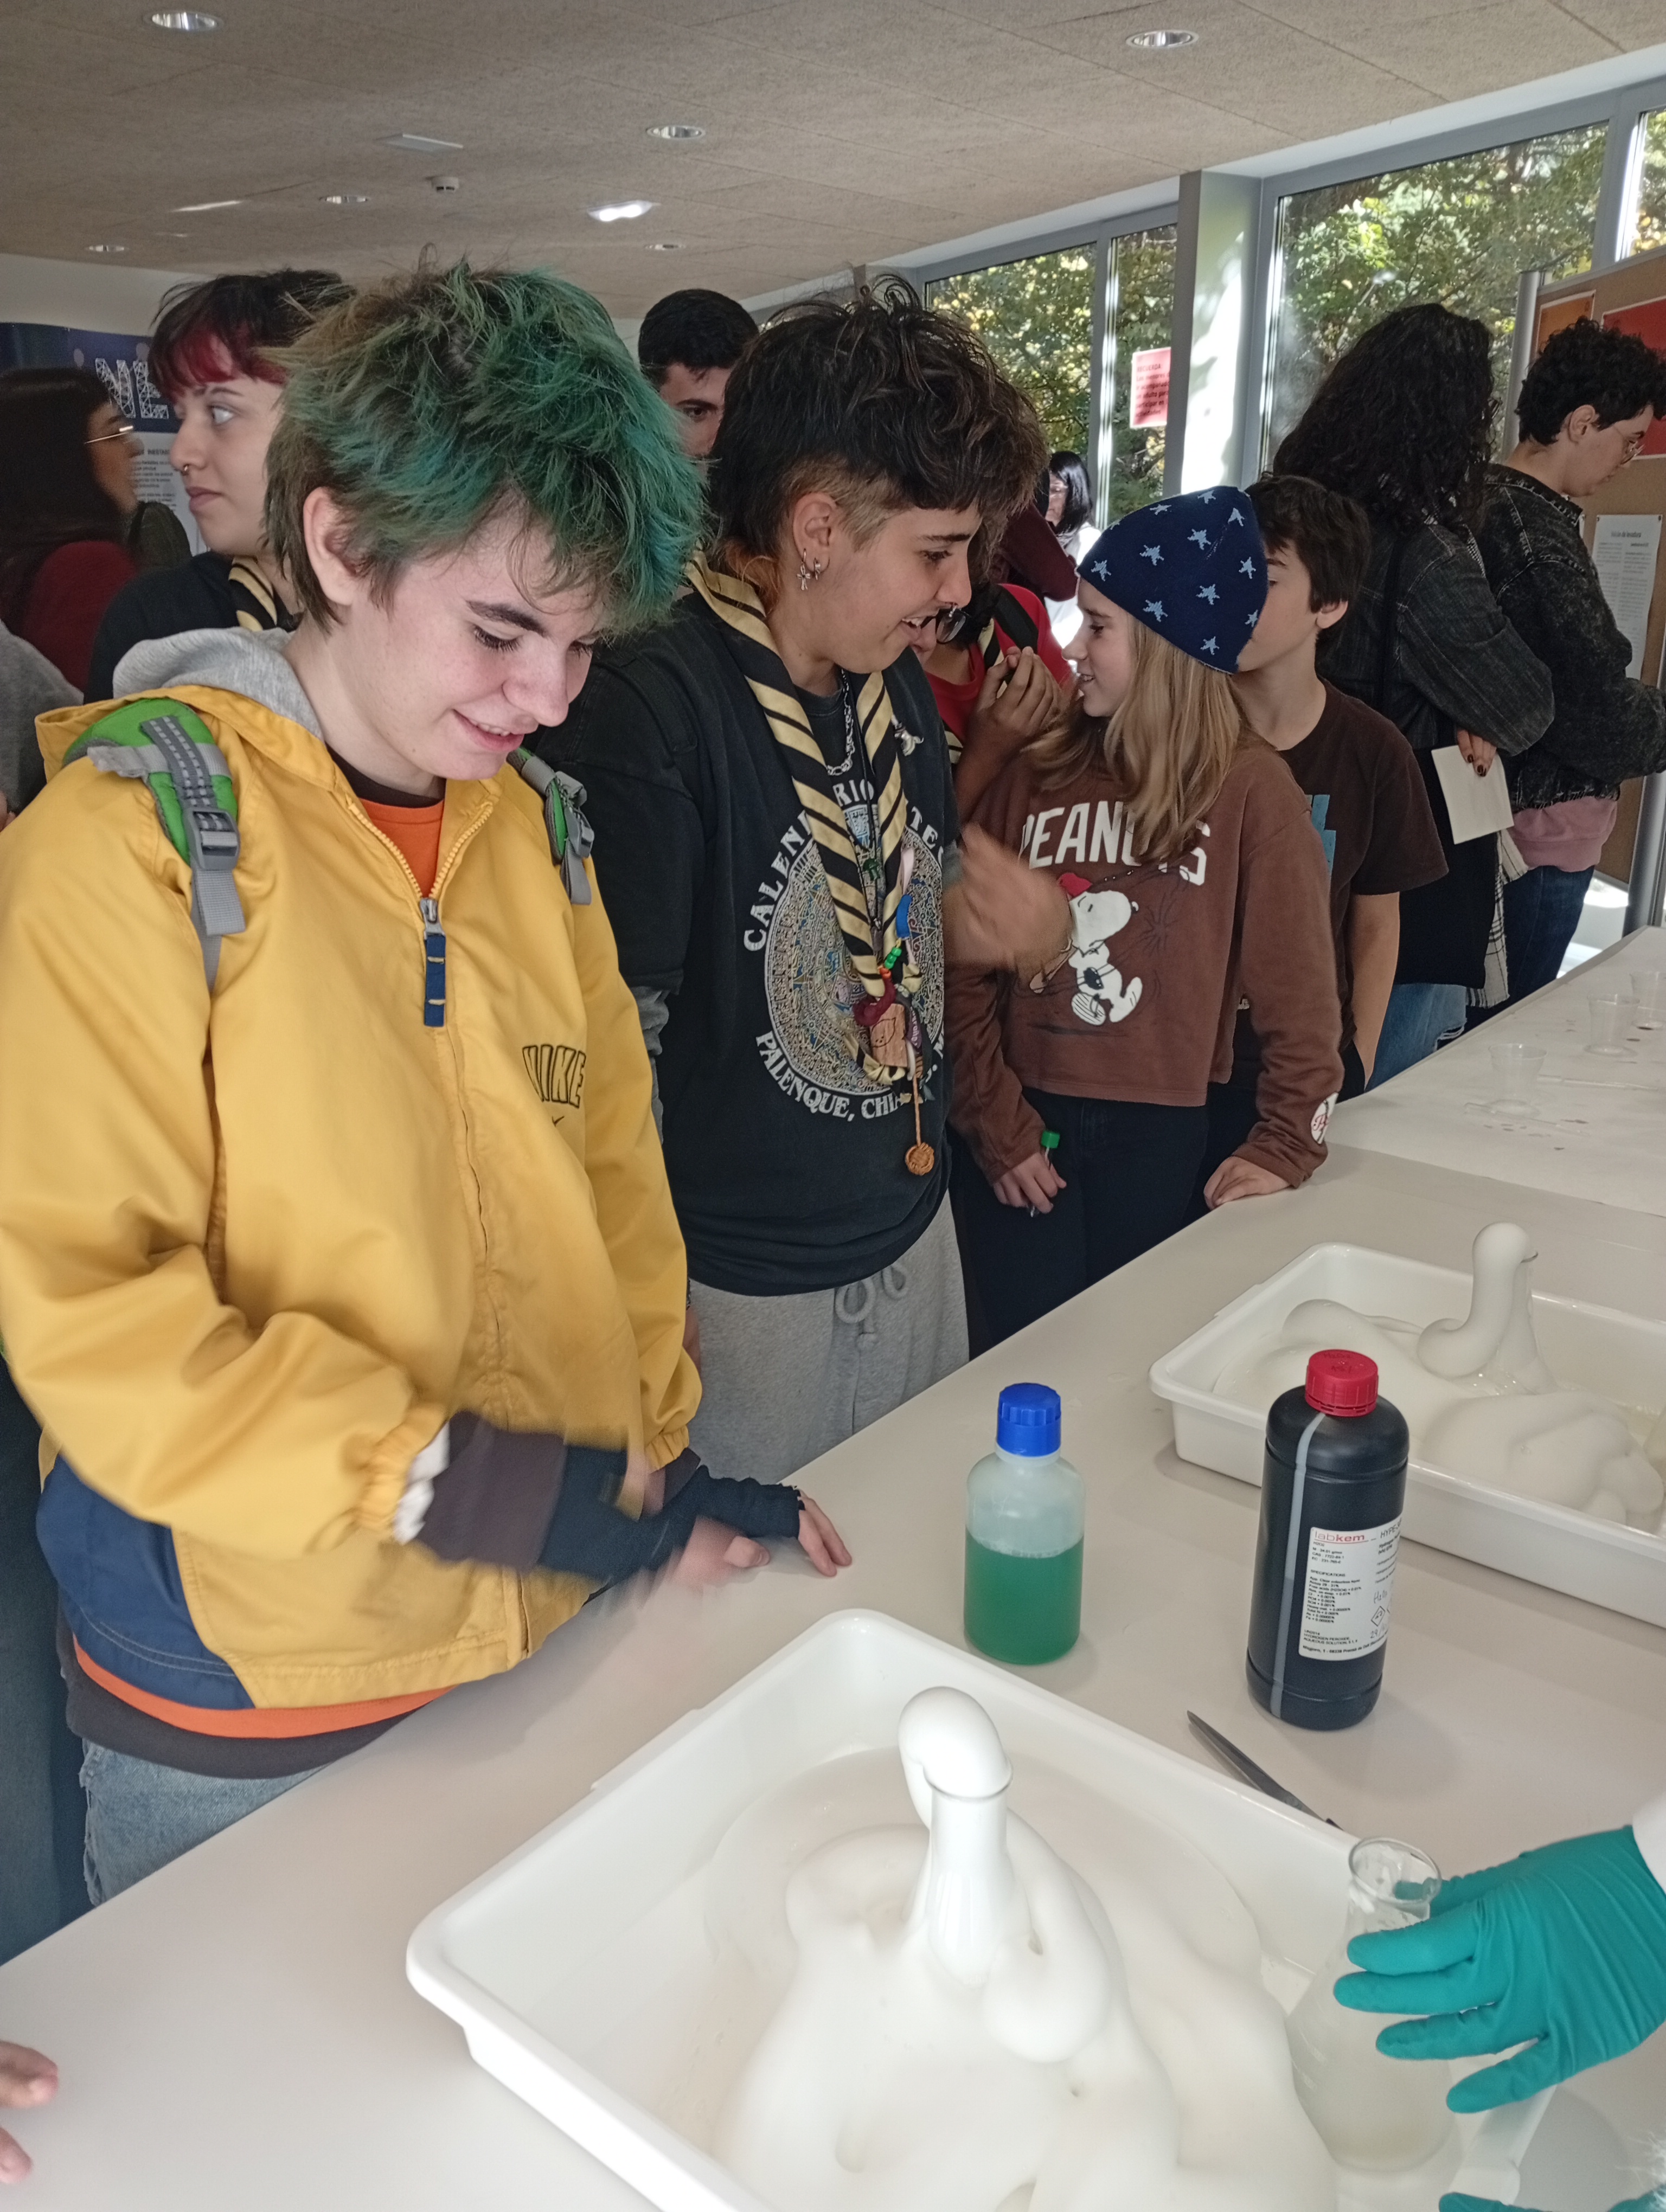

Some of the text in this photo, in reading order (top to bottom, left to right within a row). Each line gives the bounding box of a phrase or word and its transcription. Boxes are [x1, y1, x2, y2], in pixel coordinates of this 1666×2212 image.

[1018, 801, 1210, 886] PEANUS
[522, 1044, 586, 1109] NIKE
[755, 1030, 855, 1122] PALENQUE,
[1315, 1531, 1364, 1542] labkem
[1311, 1569, 1345, 1577] SPECIFICATIONS
